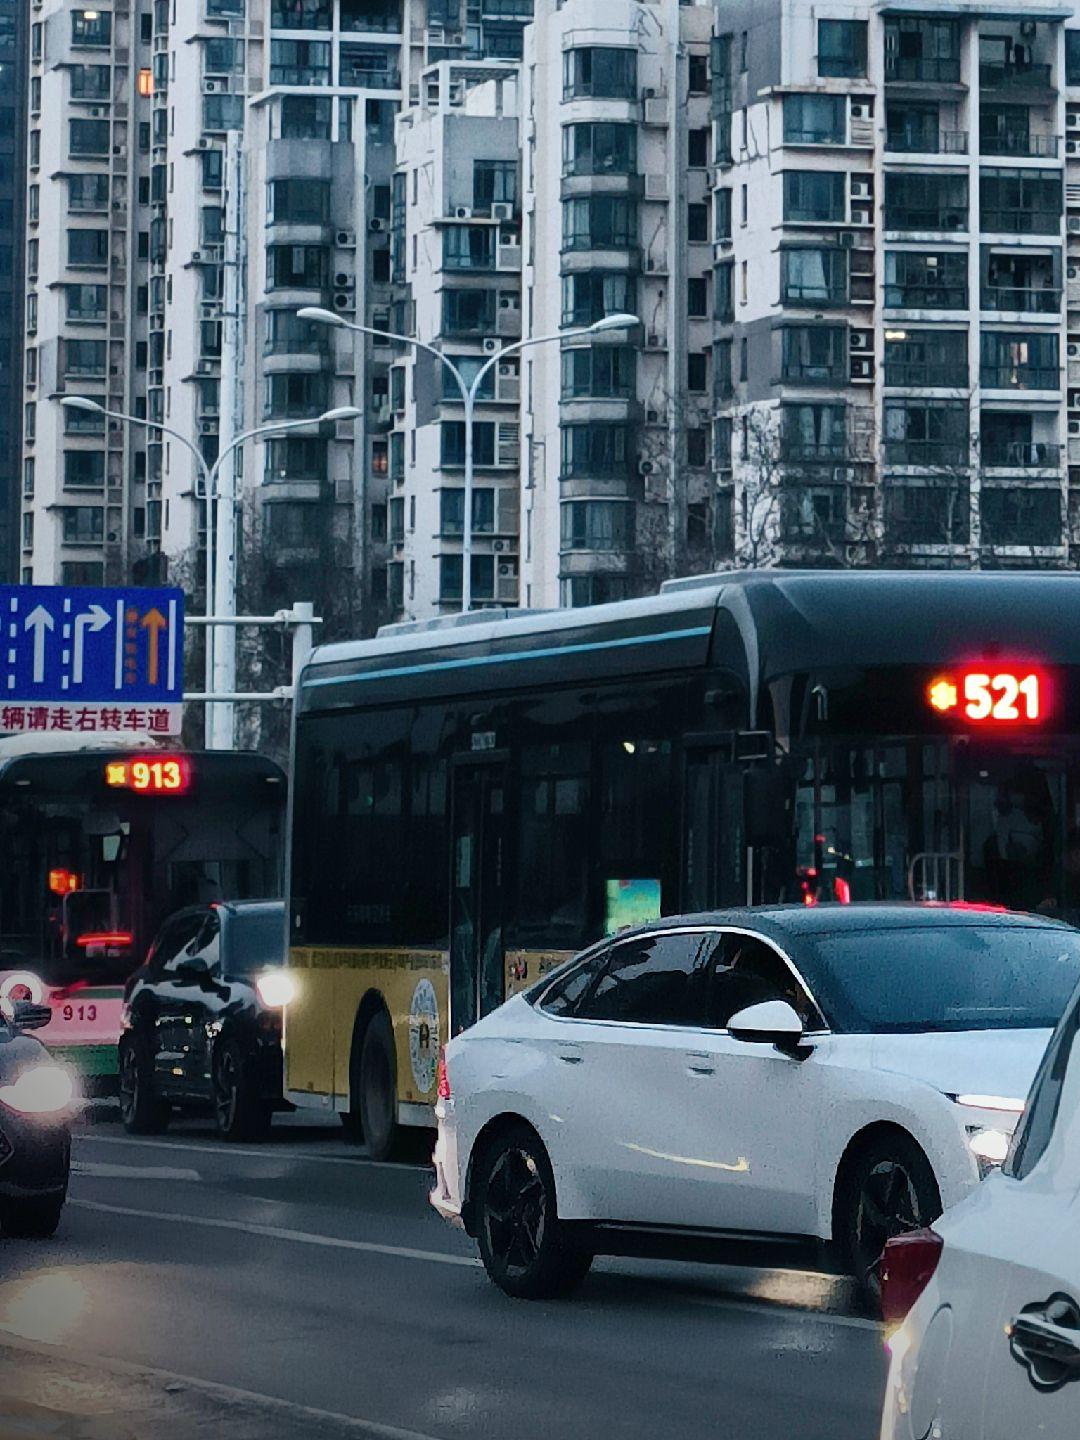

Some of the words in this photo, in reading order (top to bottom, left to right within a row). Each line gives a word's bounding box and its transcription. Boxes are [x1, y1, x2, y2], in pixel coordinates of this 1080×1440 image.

[964, 673, 1040, 720] 521
[2, 705, 171, 732] 辆请走右转车道
[132, 762, 182, 788] 913
[63, 1004, 97, 1021] 913
